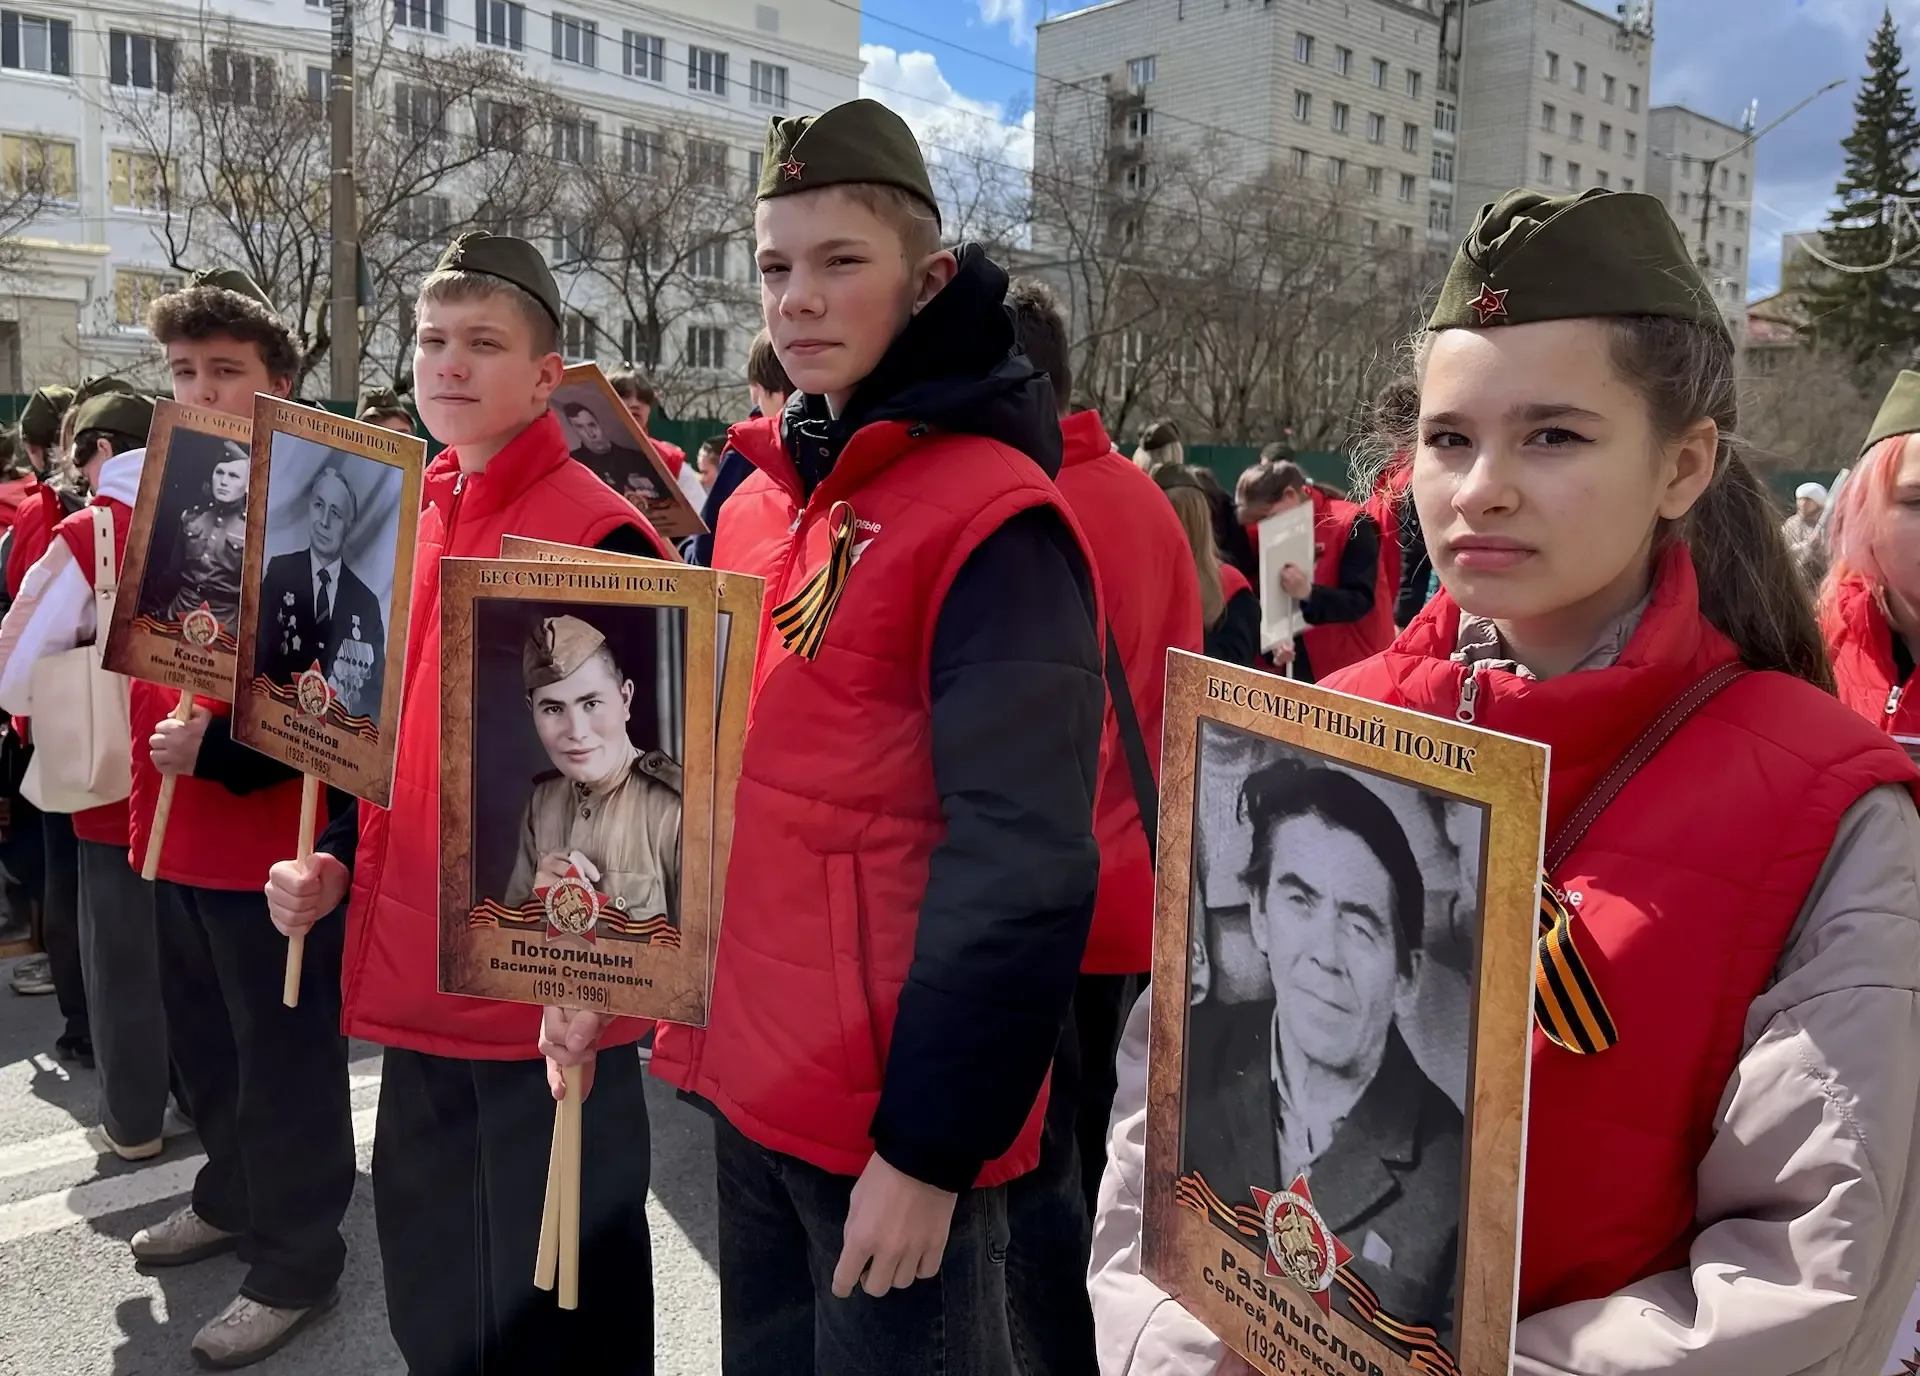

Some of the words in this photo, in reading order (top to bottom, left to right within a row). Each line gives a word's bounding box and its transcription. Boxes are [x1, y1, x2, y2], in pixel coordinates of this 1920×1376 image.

[277, 408, 363, 444] БЕССМЕРТНЫЙ
[366, 433, 400, 455] ПОЛК
[479, 568, 620, 590] БЕССМЕРТНЫЙ
[625, 576, 677, 593] ПОЛК
[150, 655, 176, 667] Иван
[178, 662, 233, 683] Андреевич
[261, 720, 300, 745] Василий
[302, 737, 359, 772] Николаевич
[283, 714, 339, 749] Семёнов
[1207, 677, 1386, 749] БЕССМЕРТНЫЙ
[1393, 728, 1476, 774] ПОЛК
[490, 958, 557, 976] Василий
[562, 966, 653, 988] Степанович
[511, 939, 633, 969] Потолицын
[533, 980, 565, 999] (1919
[1203, 1266, 1267, 1328] Сергей
[1220, 1248, 1385, 1376] Размыслов
[1246, 1324, 1286, 1373] (1926
